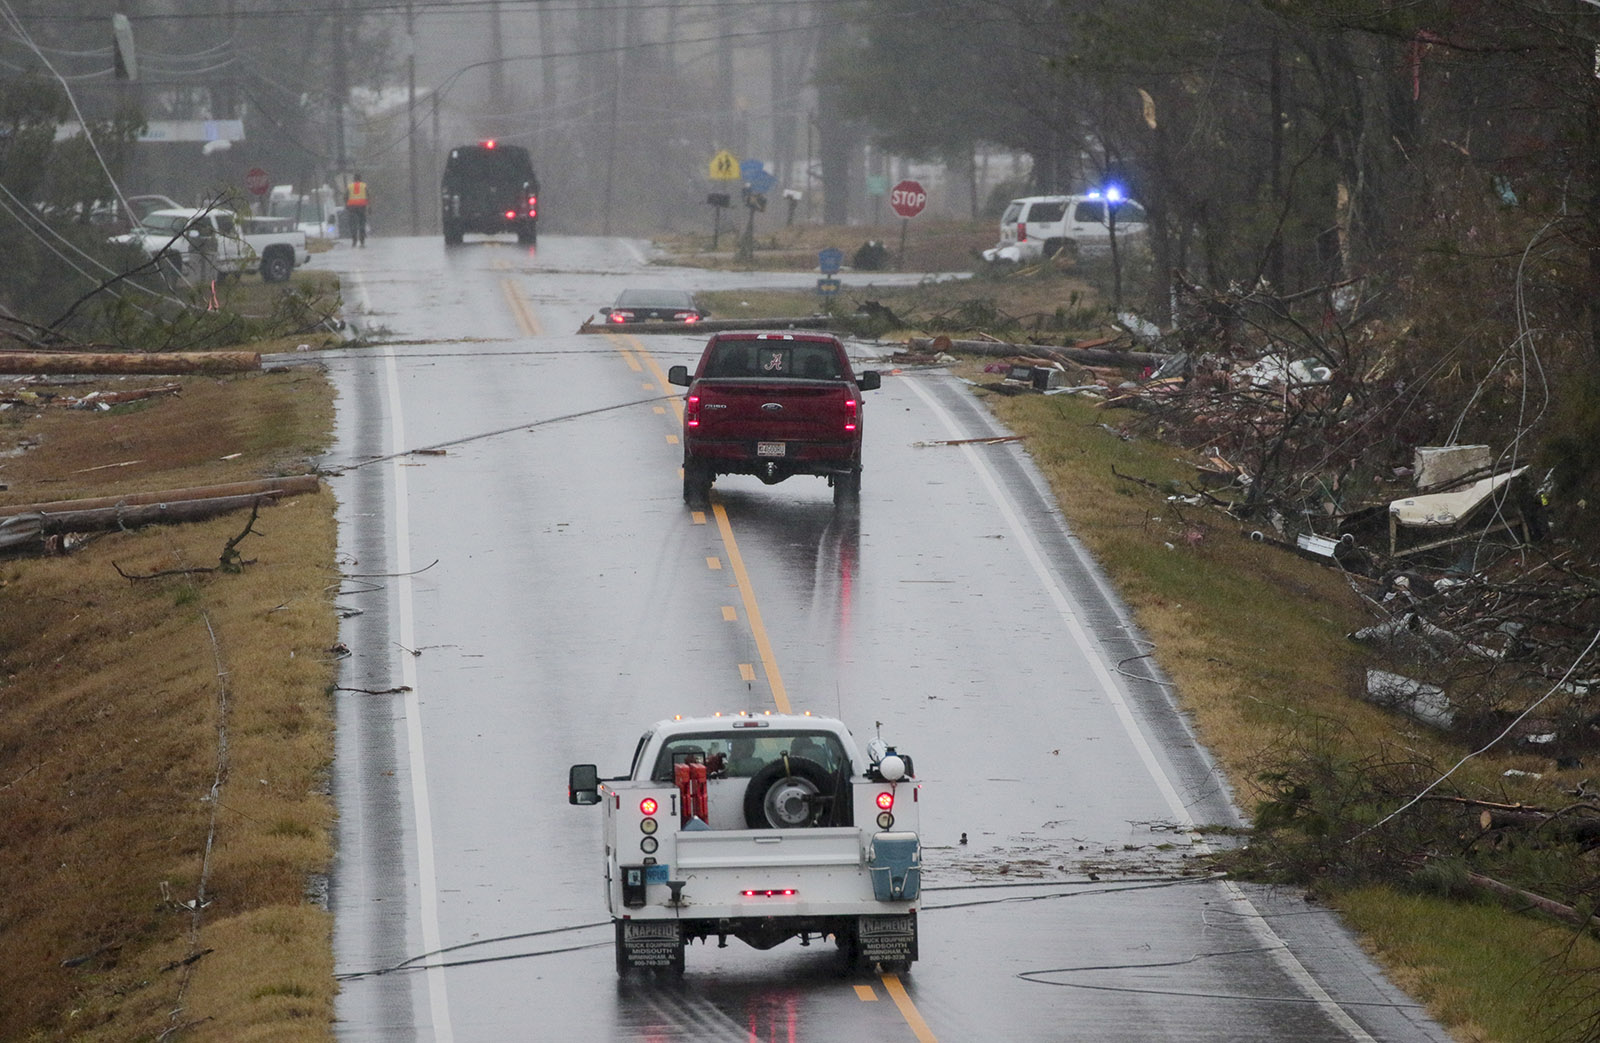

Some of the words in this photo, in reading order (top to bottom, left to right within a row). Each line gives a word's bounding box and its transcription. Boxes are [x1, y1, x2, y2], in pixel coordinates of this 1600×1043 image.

[892, 190, 925, 207] STOP
[624, 924, 680, 938] KNAPHEIDE
[859, 918, 914, 933] KNAPHEIDE
